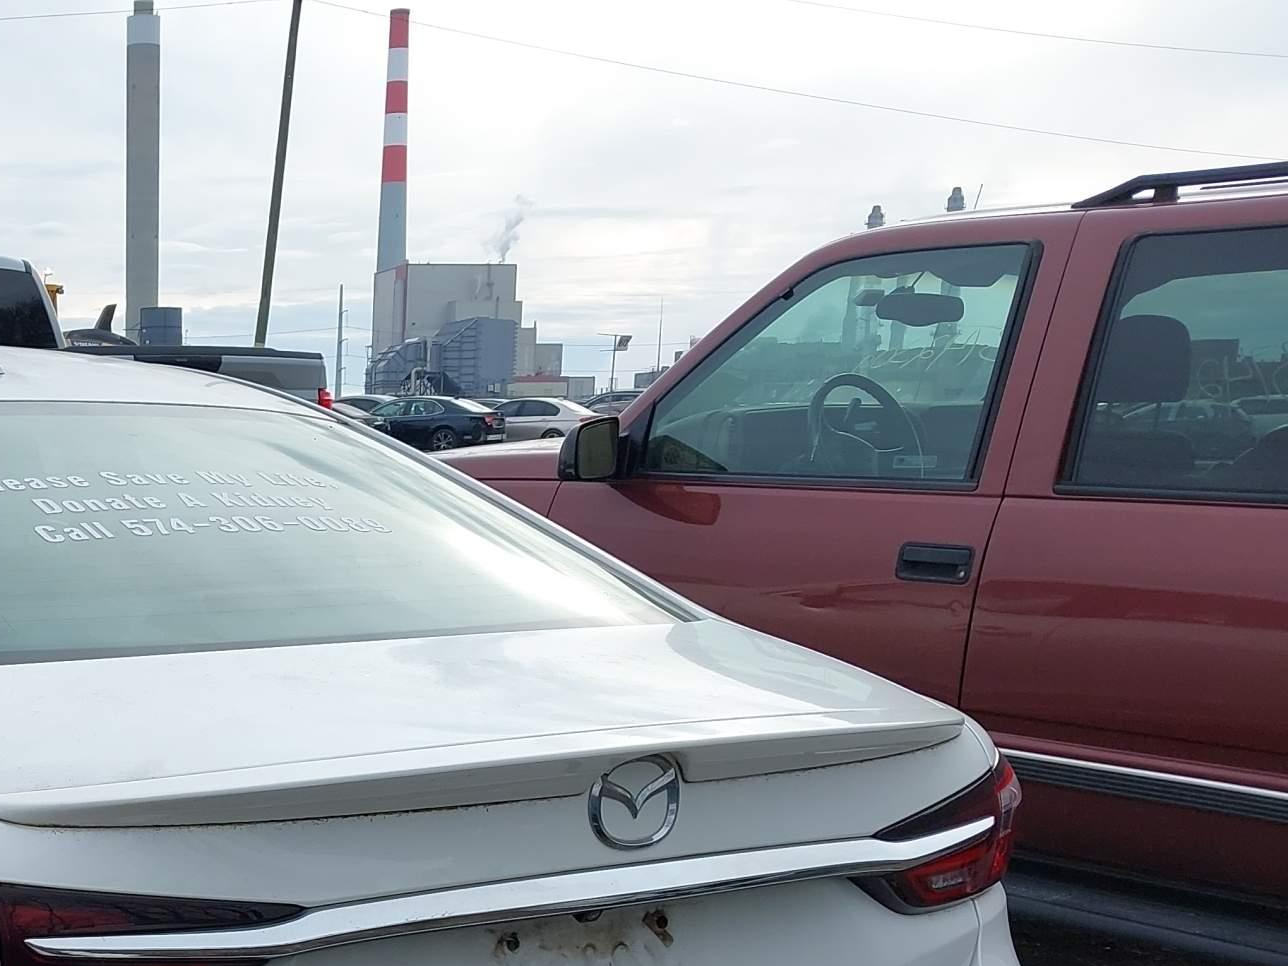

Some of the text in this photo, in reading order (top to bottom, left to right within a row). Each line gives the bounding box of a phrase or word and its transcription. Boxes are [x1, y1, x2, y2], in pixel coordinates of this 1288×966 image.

[98, 471, 191, 487] Save
[194, 471, 254, 488] My
[31, 492, 336, 515] Donate A Kidney
[33, 521, 116, 544] Call
